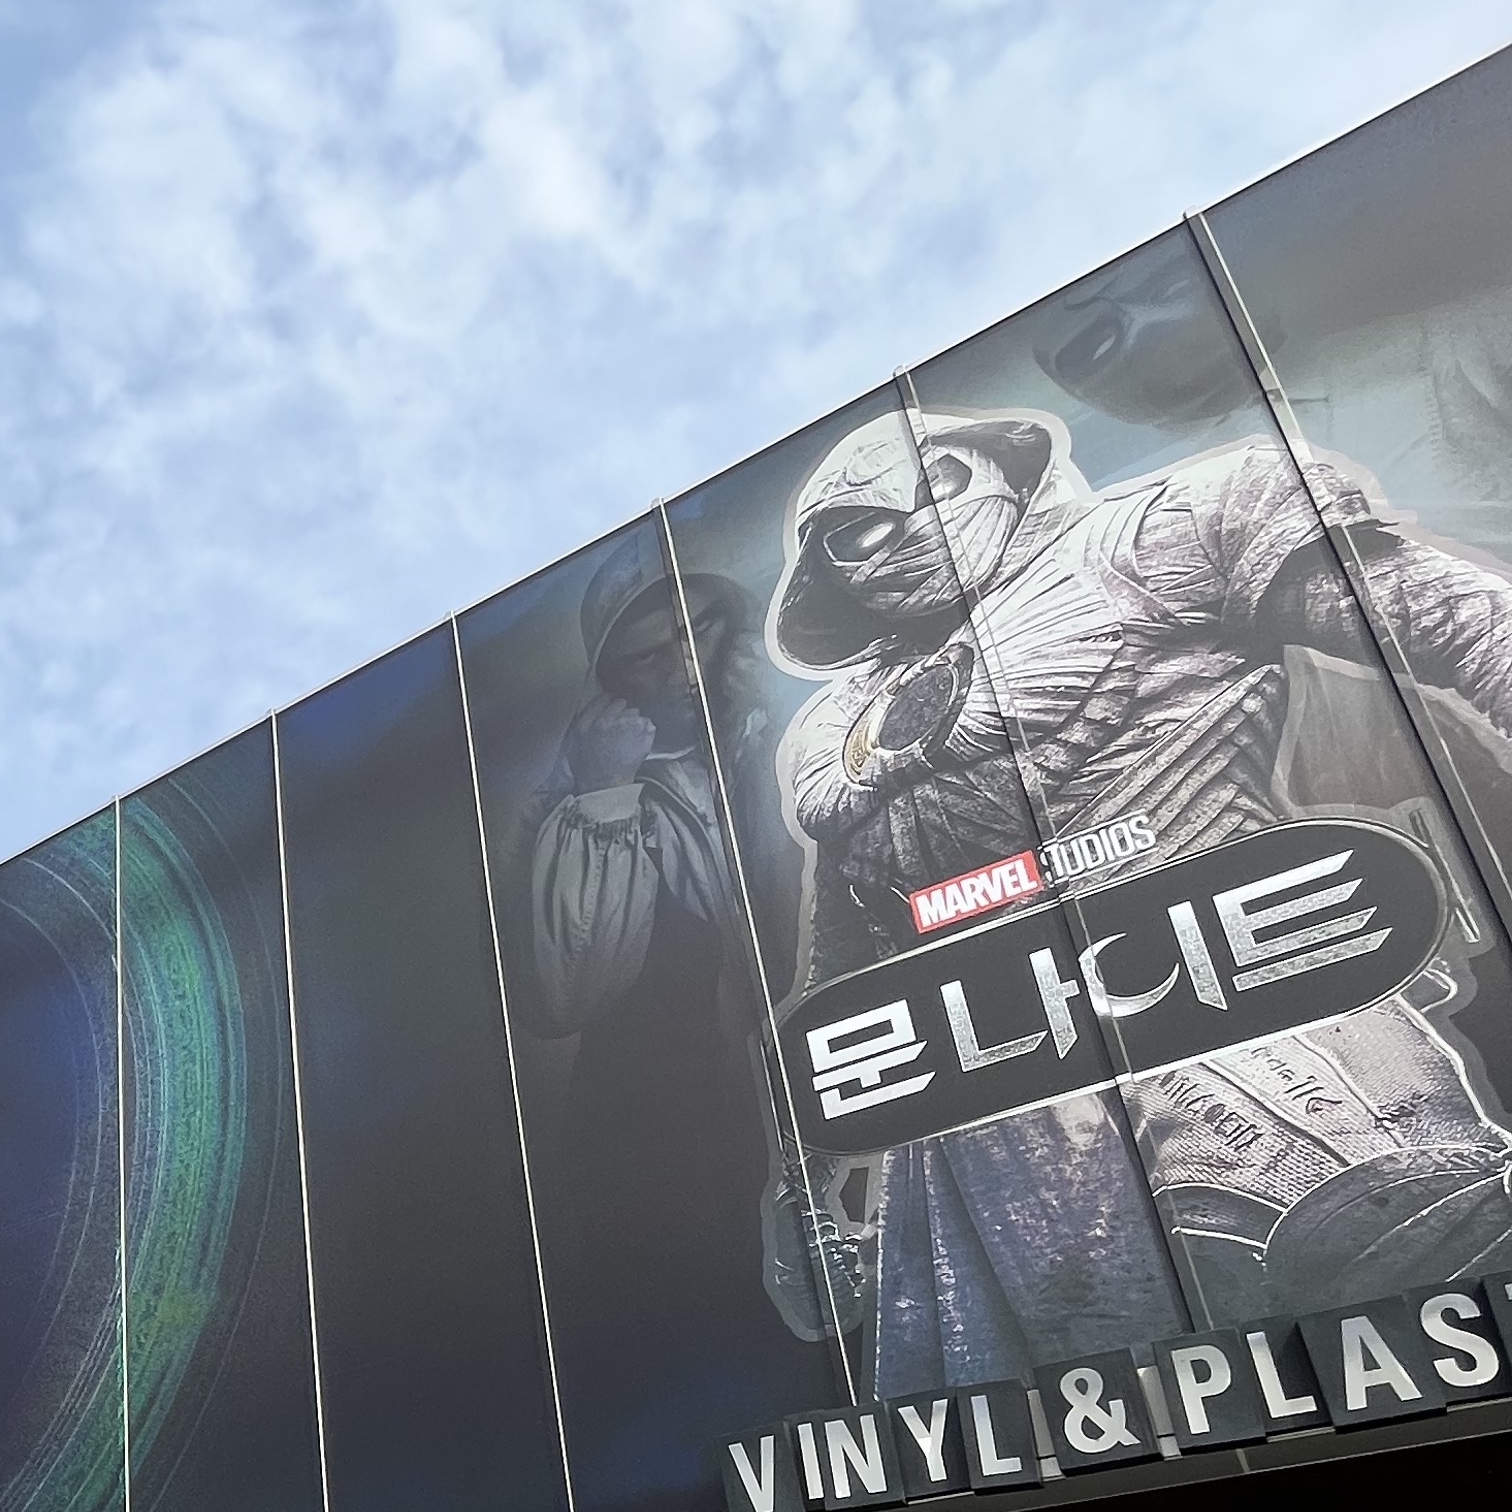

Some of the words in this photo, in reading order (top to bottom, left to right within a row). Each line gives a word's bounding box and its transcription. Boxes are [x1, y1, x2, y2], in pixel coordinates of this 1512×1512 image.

[915, 858, 1039, 929] MARVEL
[1039, 814, 1157, 887] STUDIOS
[805, 848, 1394, 1121] 문나이트
[1059, 1366, 1140, 1454] &
[1171, 1282, 1512, 1436] PLAS
